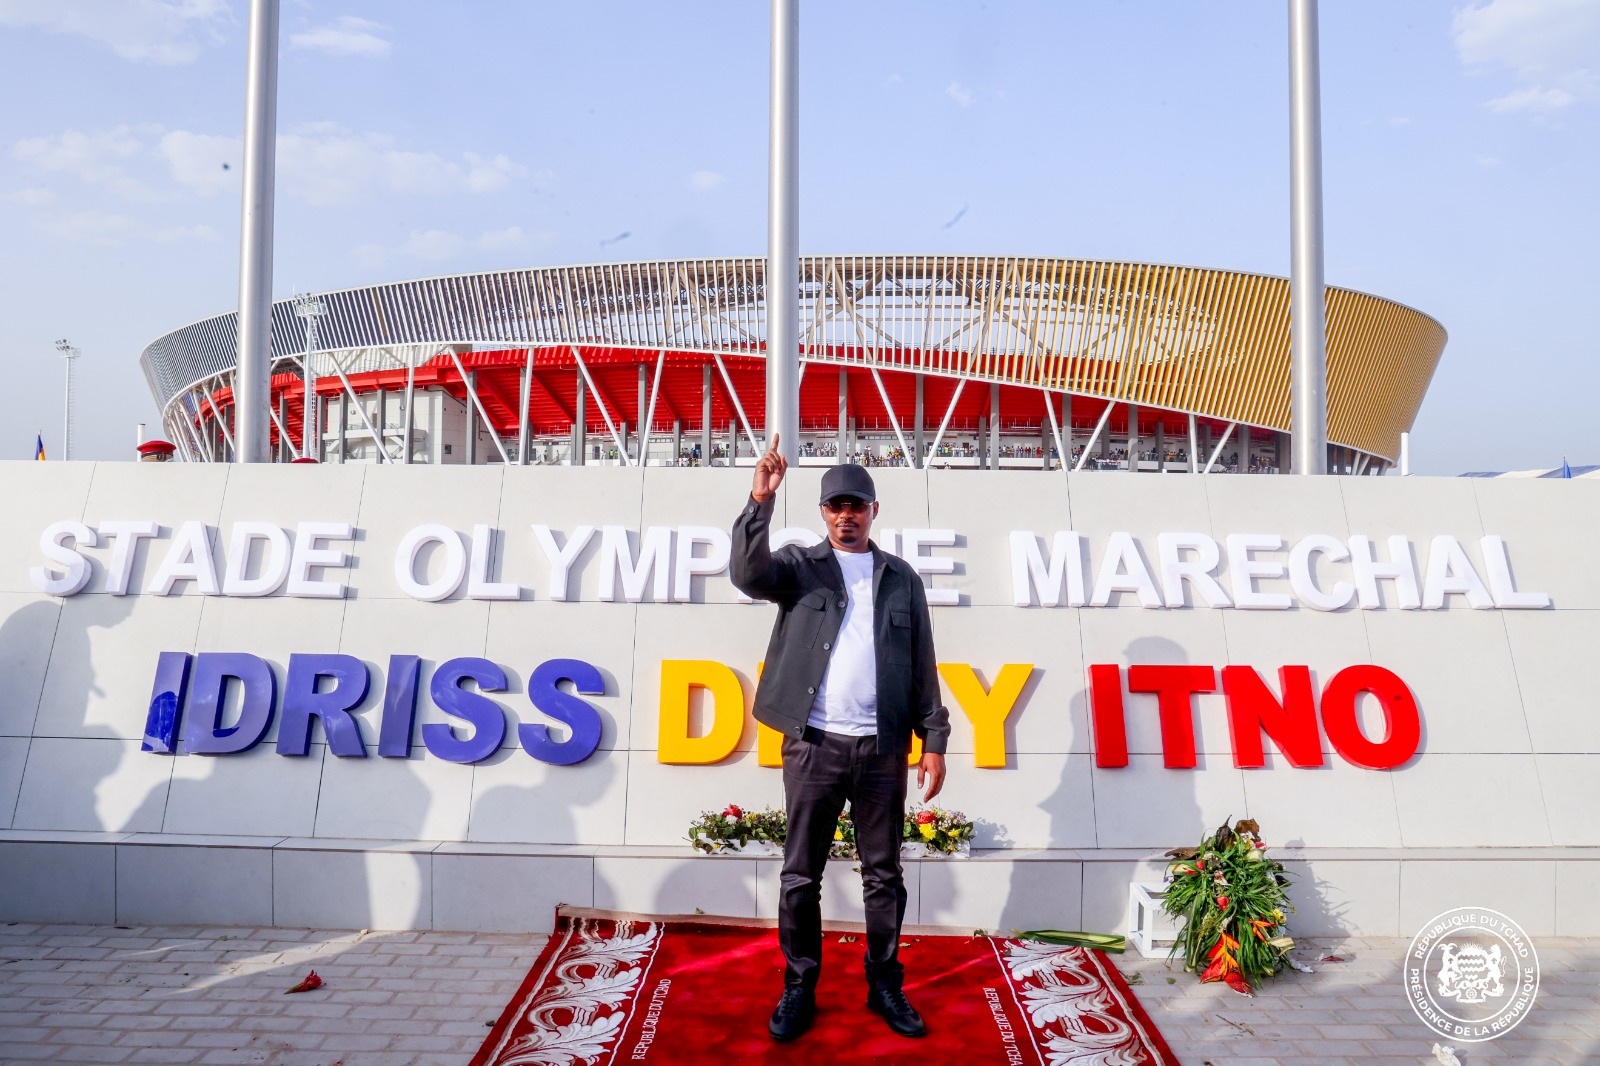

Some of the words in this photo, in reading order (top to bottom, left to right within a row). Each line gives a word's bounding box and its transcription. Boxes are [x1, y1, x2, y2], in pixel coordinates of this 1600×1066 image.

[29, 521, 353, 598] STADE
[395, 524, 959, 606] OLYMPE
[1009, 530, 1550, 611] MARECHAL
[141, 651, 605, 765] IDRISS
[657, 660, 1035, 768] DY
[1088, 664, 1421, 770] ITNO
